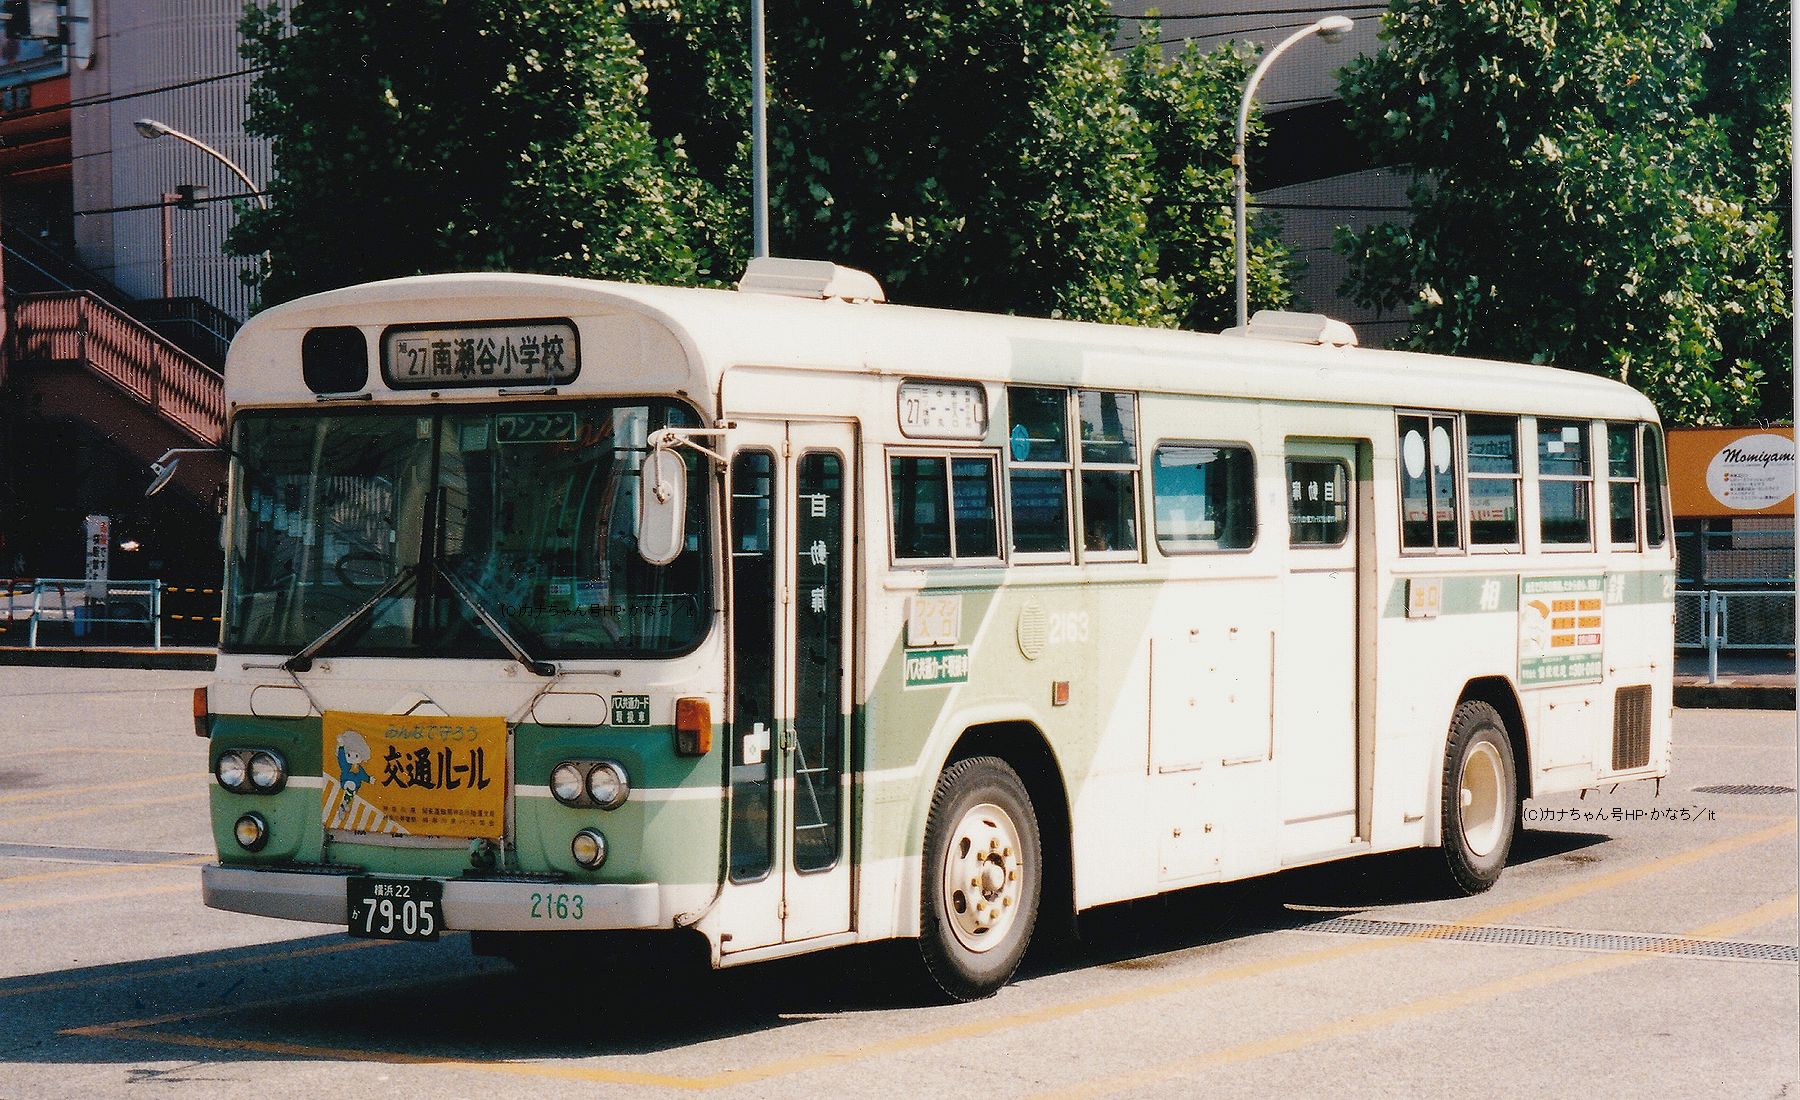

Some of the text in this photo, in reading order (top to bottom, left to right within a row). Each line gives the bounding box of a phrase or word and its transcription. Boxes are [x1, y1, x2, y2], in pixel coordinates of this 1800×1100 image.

[407, 347, 428, 376] 27
[431, 334, 565, 376] 南瀬谷小学校
[906, 398, 920, 424] 27
[499, 415, 574, 438] ワンマン
[1048, 611, 1089, 643] 2163
[611, 696, 649, 709] バス共通カード
[384, 723, 479, 742] みんなで守ろう
[381, 745, 491, 790] 交通ルール
[363, 898, 434, 936] 79-05
[530, 892, 585, 920] 2163
